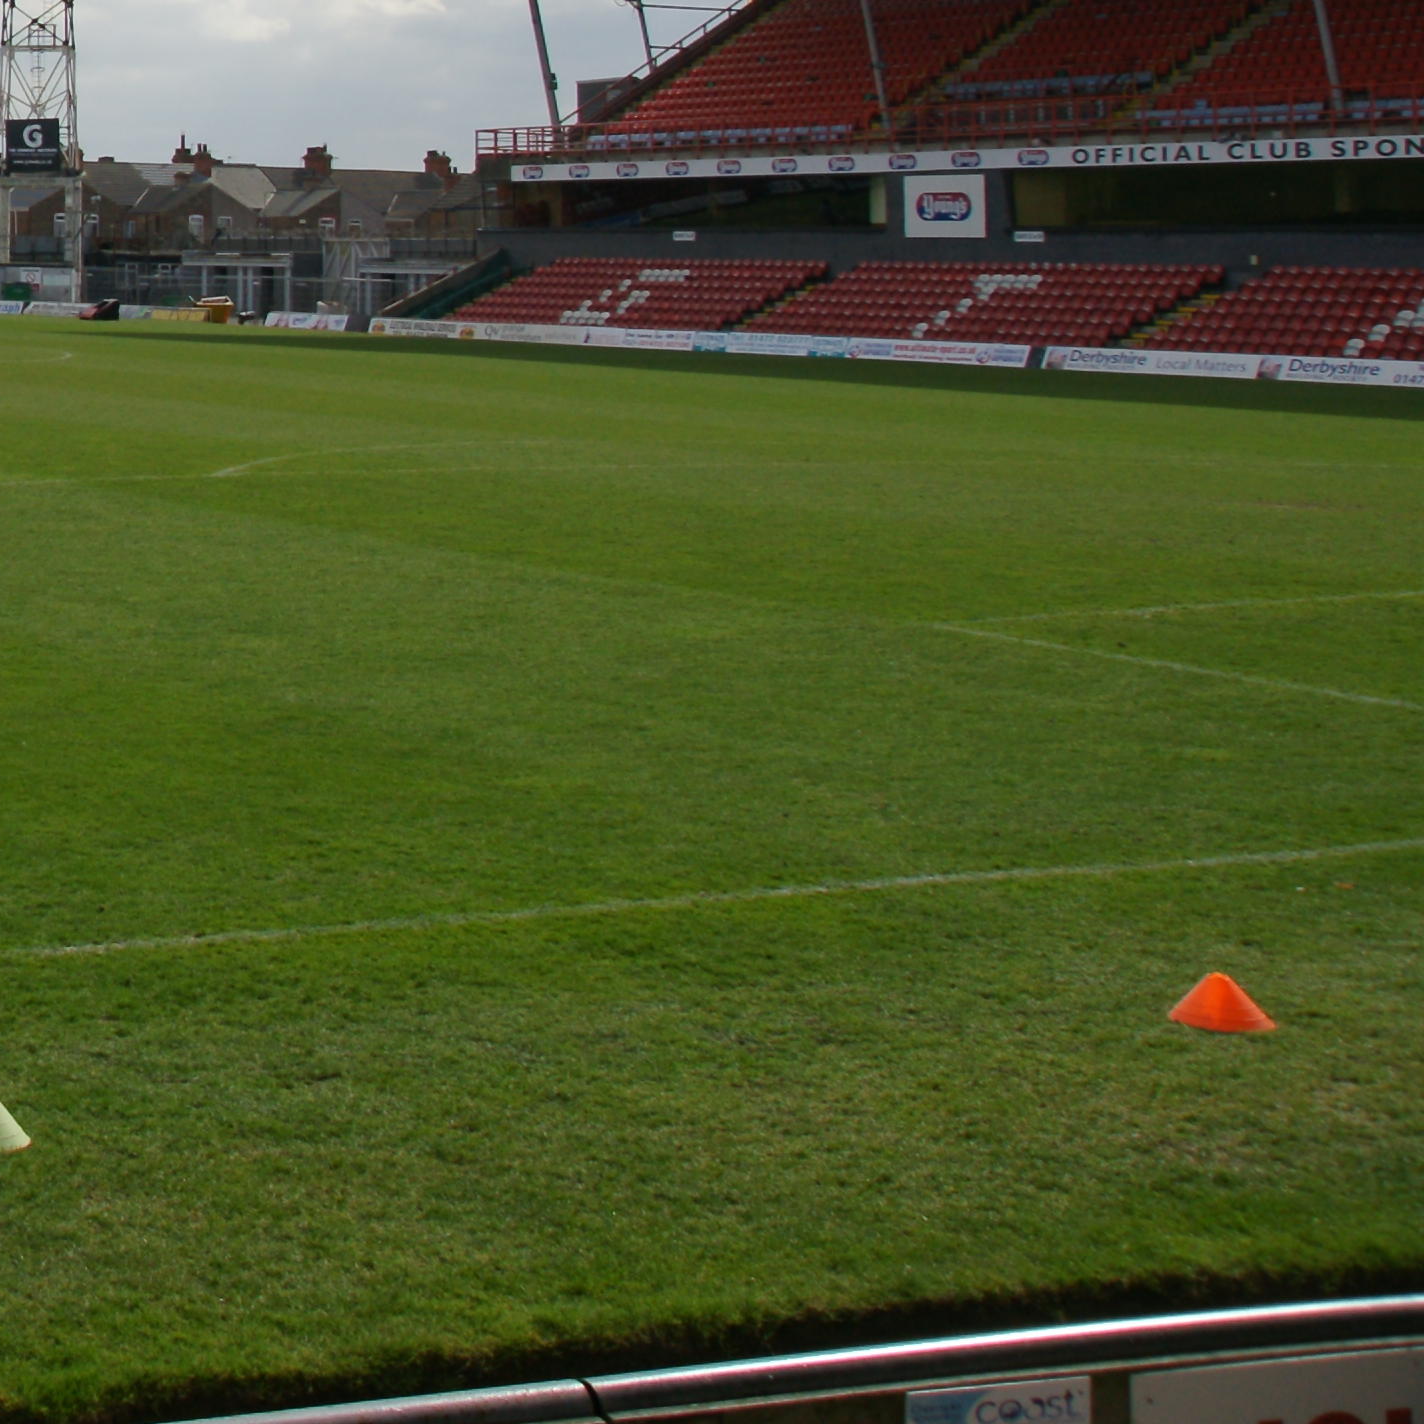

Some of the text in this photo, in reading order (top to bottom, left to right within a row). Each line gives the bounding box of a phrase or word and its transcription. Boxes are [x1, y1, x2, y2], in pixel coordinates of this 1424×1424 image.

[22, 124, 44, 148] G
[1072, 144, 1211, 164] OFFICIAL
[1227, 141, 1311, 159] CLUB
[921, 194, 969, 219] Young's
[1069, 349, 1246, 373] Derbyshire Local Matters
[1288, 358, 1381, 377] Derbyshire
